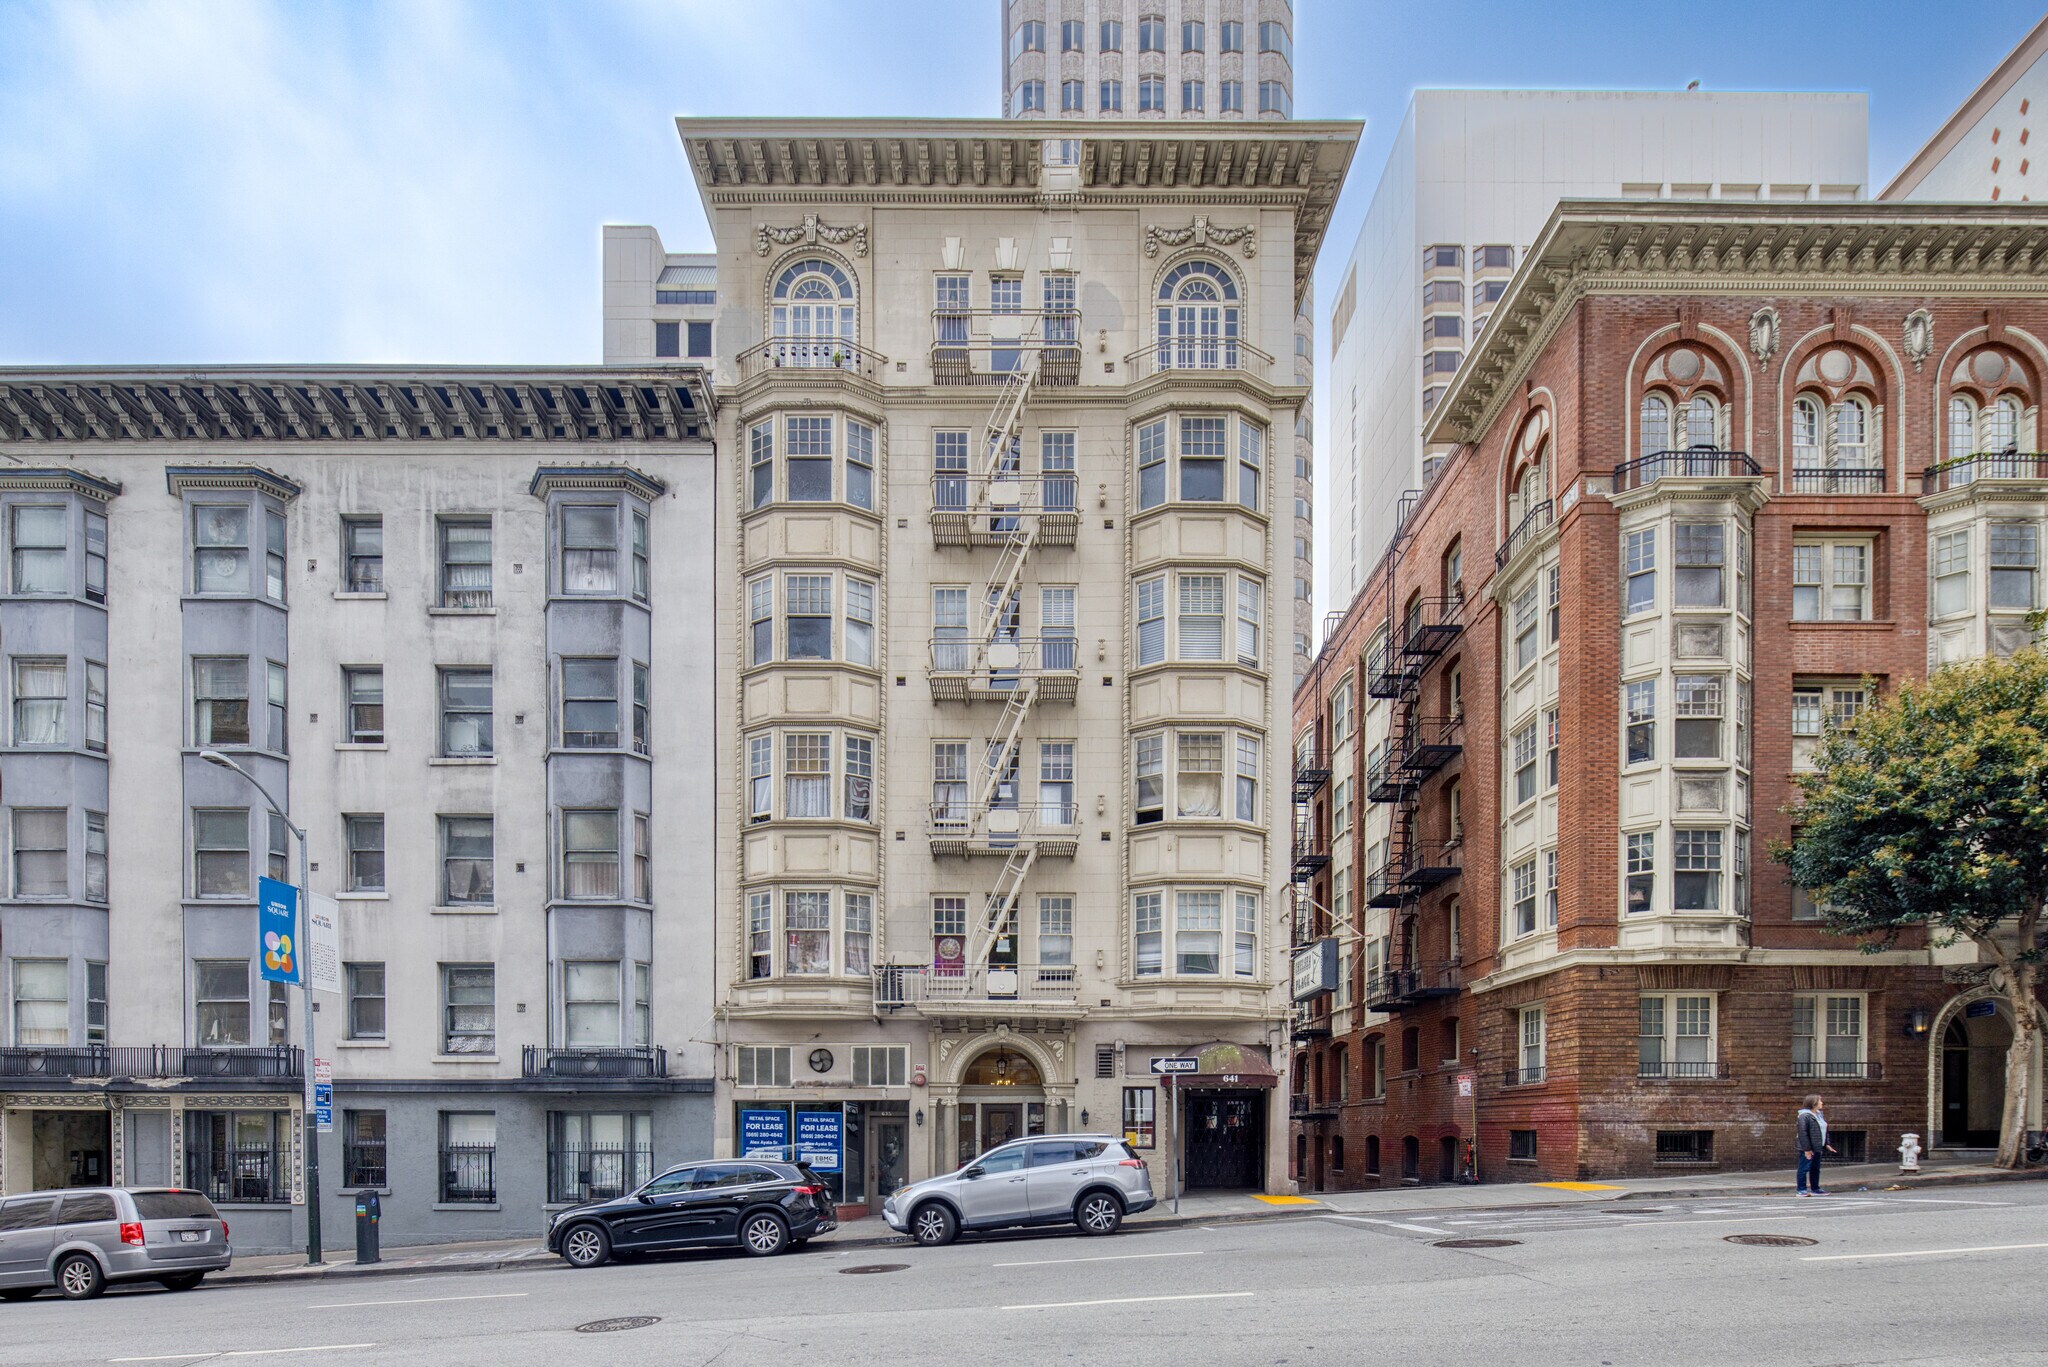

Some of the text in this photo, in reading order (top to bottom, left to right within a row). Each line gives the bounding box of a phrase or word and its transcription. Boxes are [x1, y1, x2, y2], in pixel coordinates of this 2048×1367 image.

[271, 901, 286, 909] UNION
[267, 905, 289, 918] SQUARE
[311, 918, 332, 929] SQUARE
[1296, 974, 1310, 991] PLACE
[1222, 1074, 1239, 1083] 641
